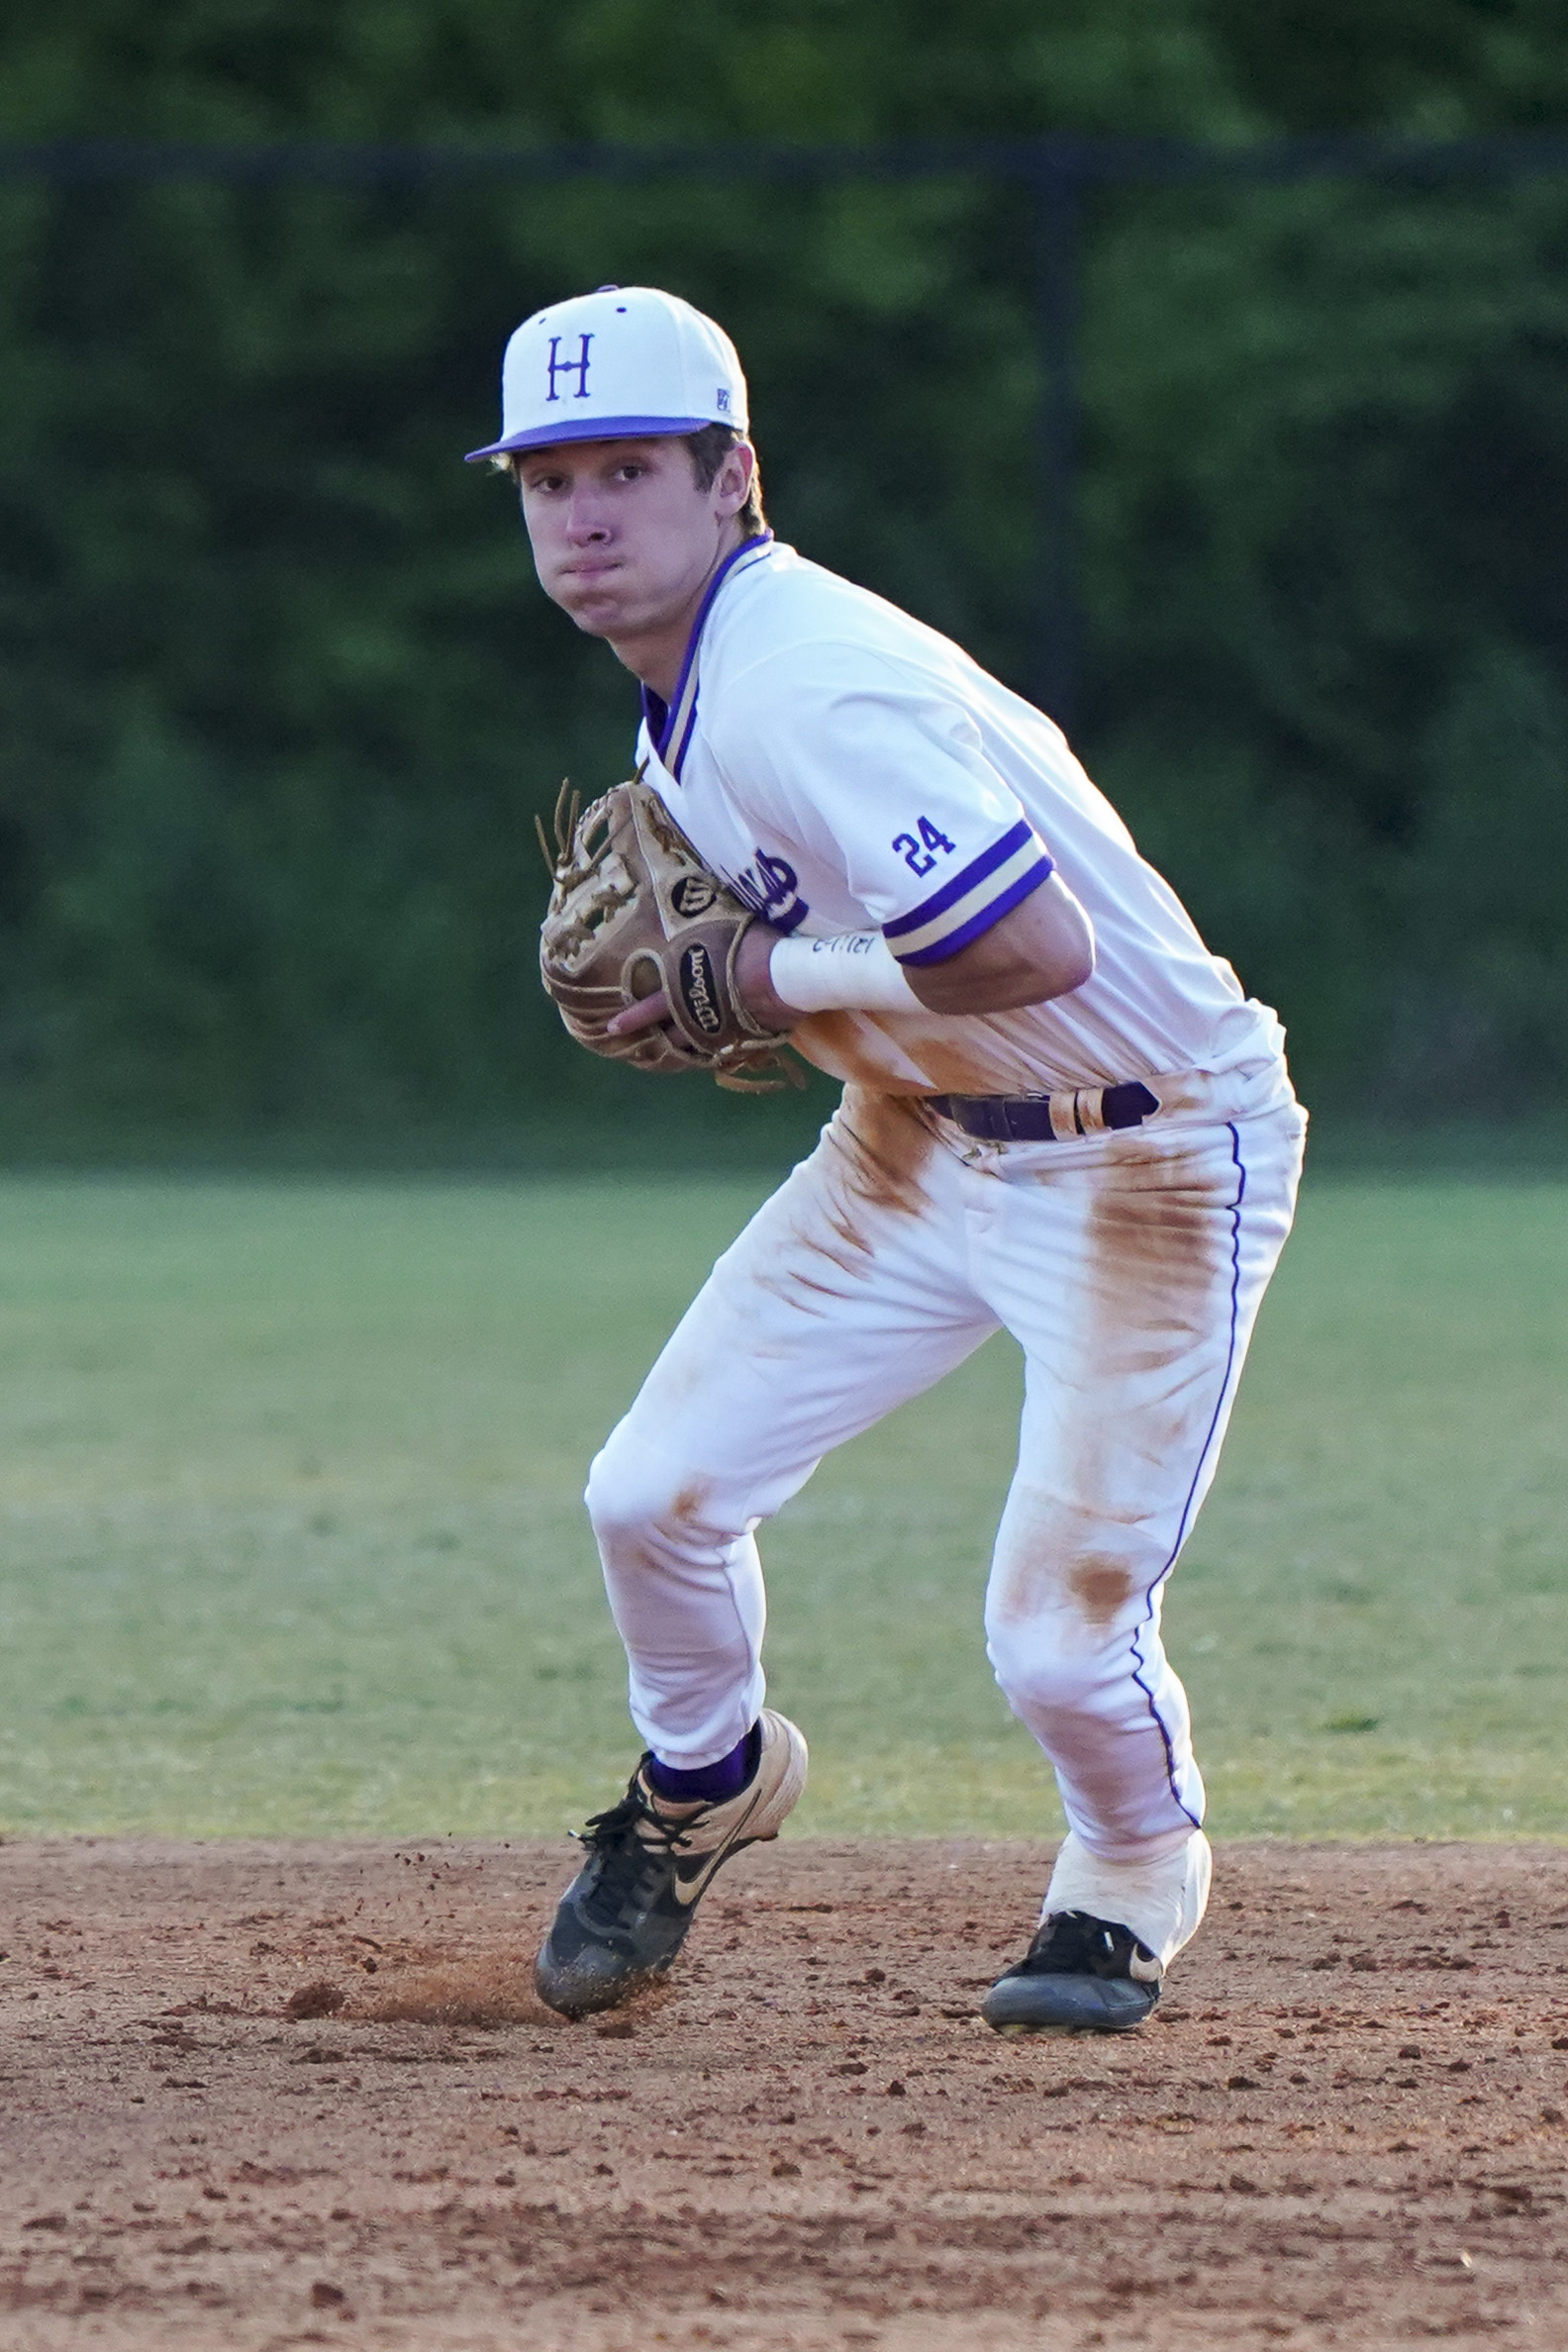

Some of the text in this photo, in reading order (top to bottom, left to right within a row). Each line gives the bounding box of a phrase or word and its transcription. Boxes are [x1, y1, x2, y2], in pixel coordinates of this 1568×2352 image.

[545, 333, 595, 401] H
[892, 815, 956, 878] 24
[688, 948, 720, 1030] Wilson
